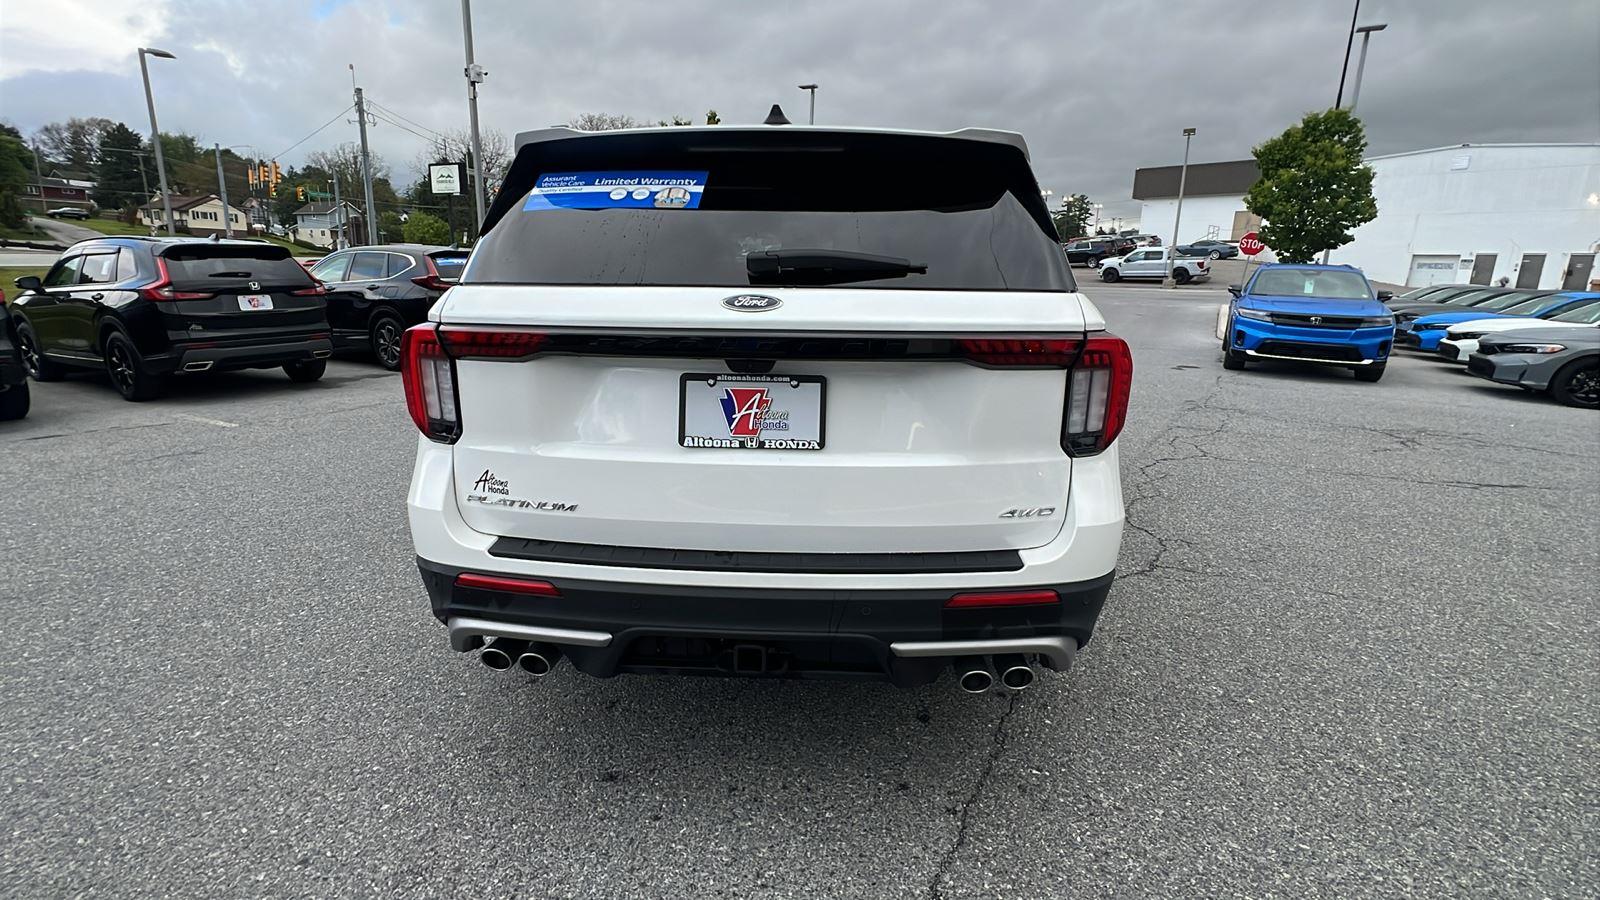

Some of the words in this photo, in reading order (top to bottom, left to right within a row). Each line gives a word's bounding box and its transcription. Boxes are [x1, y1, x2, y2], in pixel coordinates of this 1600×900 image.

[594, 177, 639, 186] Limited
[640, 177, 697, 187] Warranty
[734, 295, 769, 307] Ford
[716, 374, 791, 382] altoonahonda.com
[730, 392, 789, 430] Altoona
[753, 419, 788, 430] Honda
[683, 436, 740, 448] Altoona
[763, 439, 820, 450] HONDA
[473, 469, 509, 492] Altoona
[487, 486, 510, 496] Honda
[466, 494, 579, 512] PLATINUM
[998, 507, 1056, 519] 4WD
